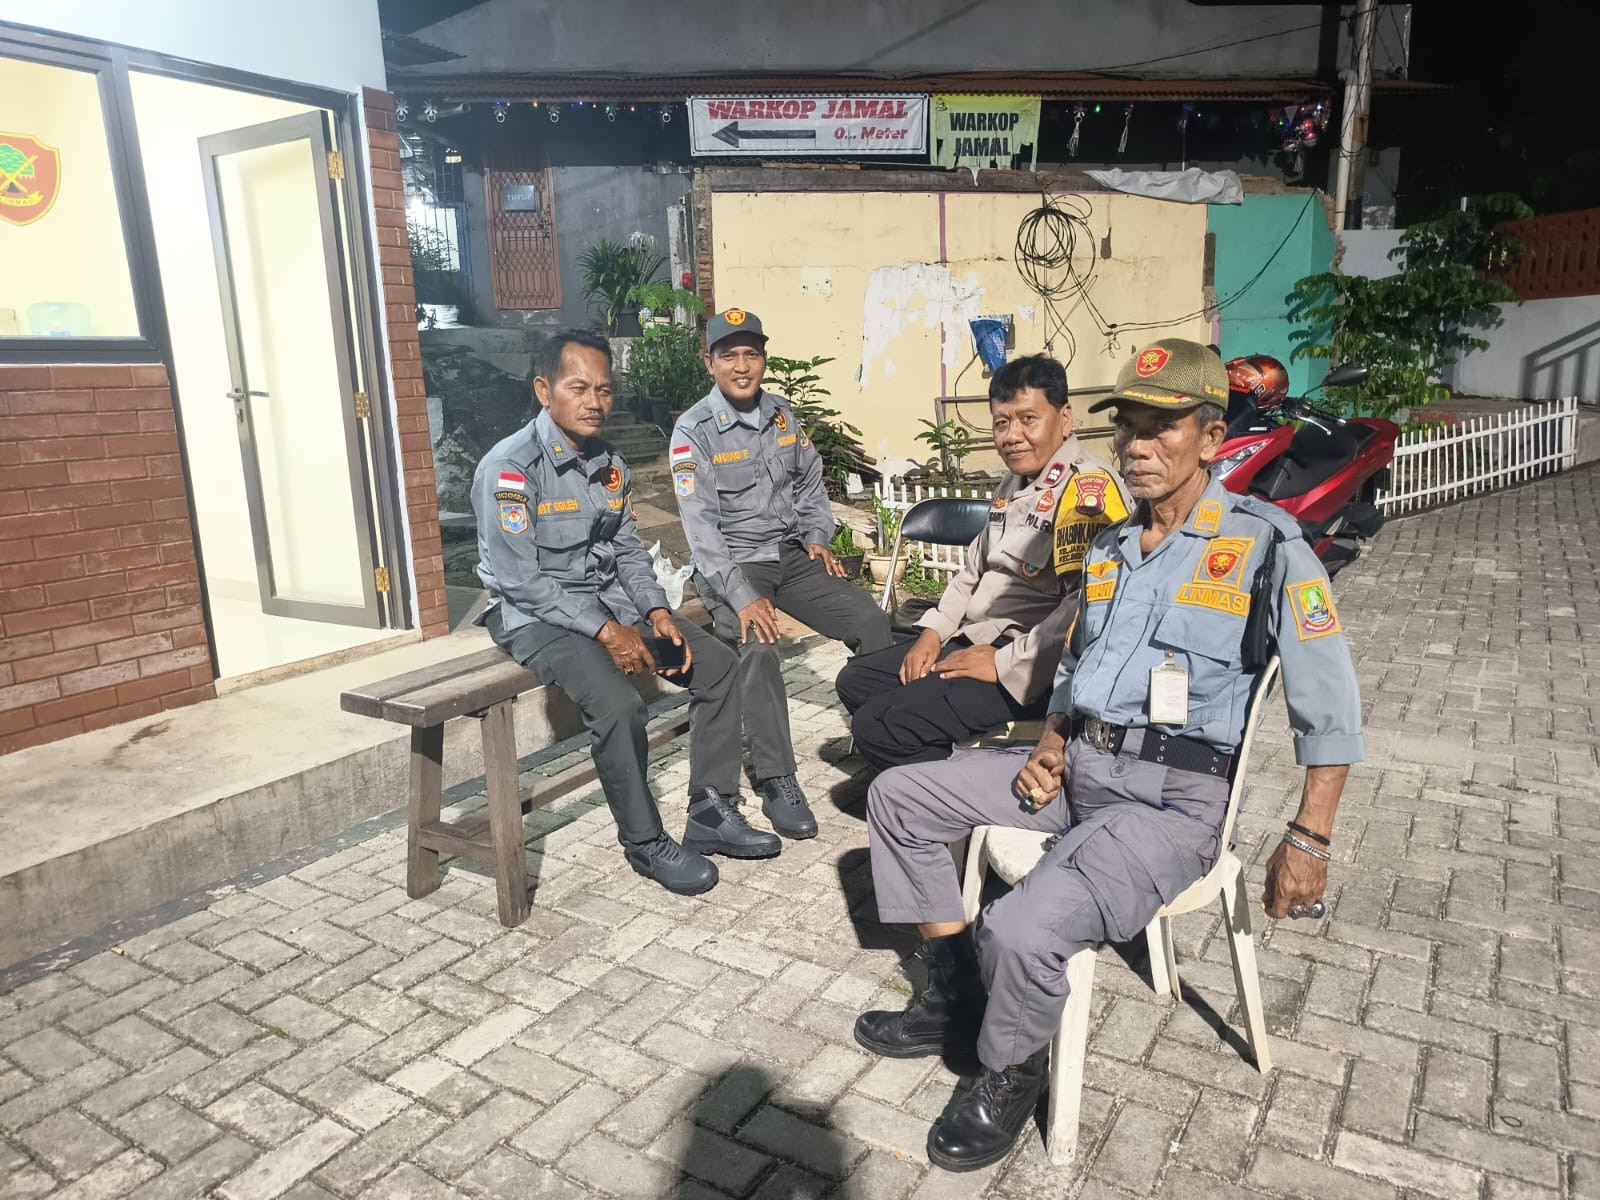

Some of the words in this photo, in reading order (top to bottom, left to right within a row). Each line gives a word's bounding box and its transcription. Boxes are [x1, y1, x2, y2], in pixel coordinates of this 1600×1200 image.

[707, 100, 816, 120] WARKOP
[821, 100, 908, 119] JAMAL
[949, 112, 1019, 131] WARKOP
[860, 127, 908, 139] Meter
[953, 137, 1011, 156] JAMAL
